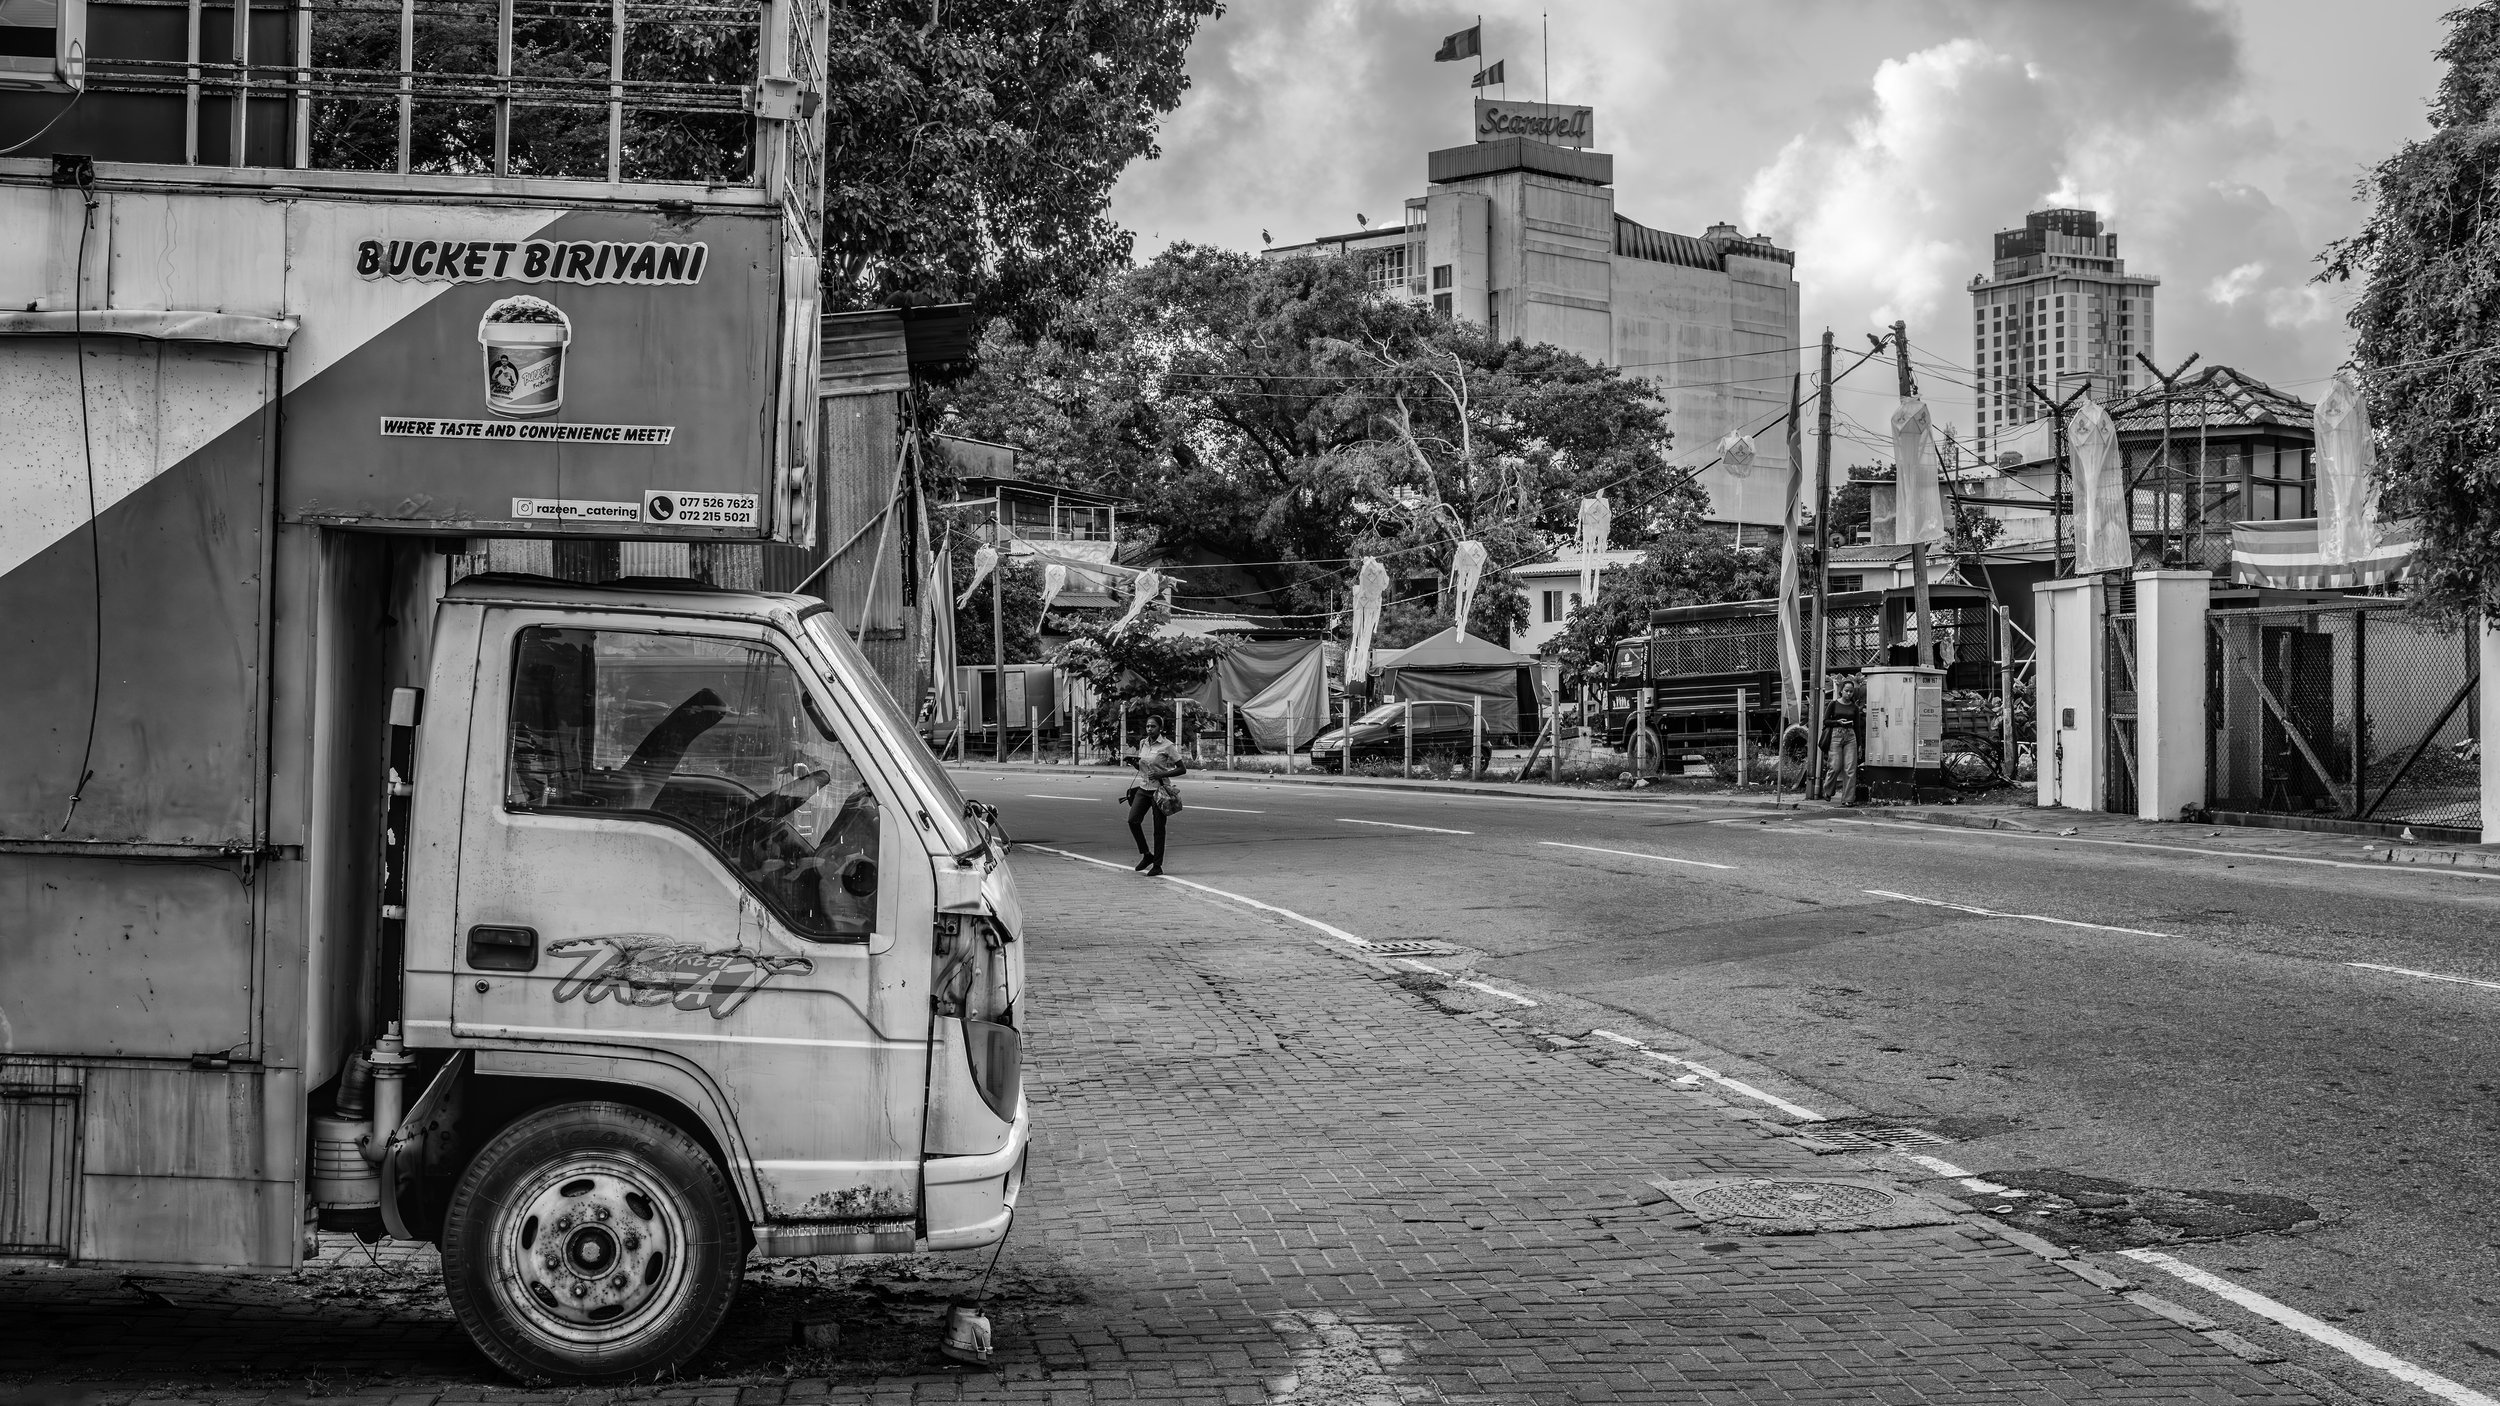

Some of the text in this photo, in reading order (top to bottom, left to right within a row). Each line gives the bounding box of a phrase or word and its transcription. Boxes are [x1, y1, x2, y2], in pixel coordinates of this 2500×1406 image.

[1479, 108, 1591, 138] Scanwell
[357, 241, 706, 282] BUCKET BIRIYANI
[384, 420, 671, 443] WHERE TASTE AND CONVENIENCE MEET!
[537, 503, 637, 520] razeen_catering
[679, 497, 754, 509] 077 526 7623
[679, 511, 750, 523] 072 215 5021
